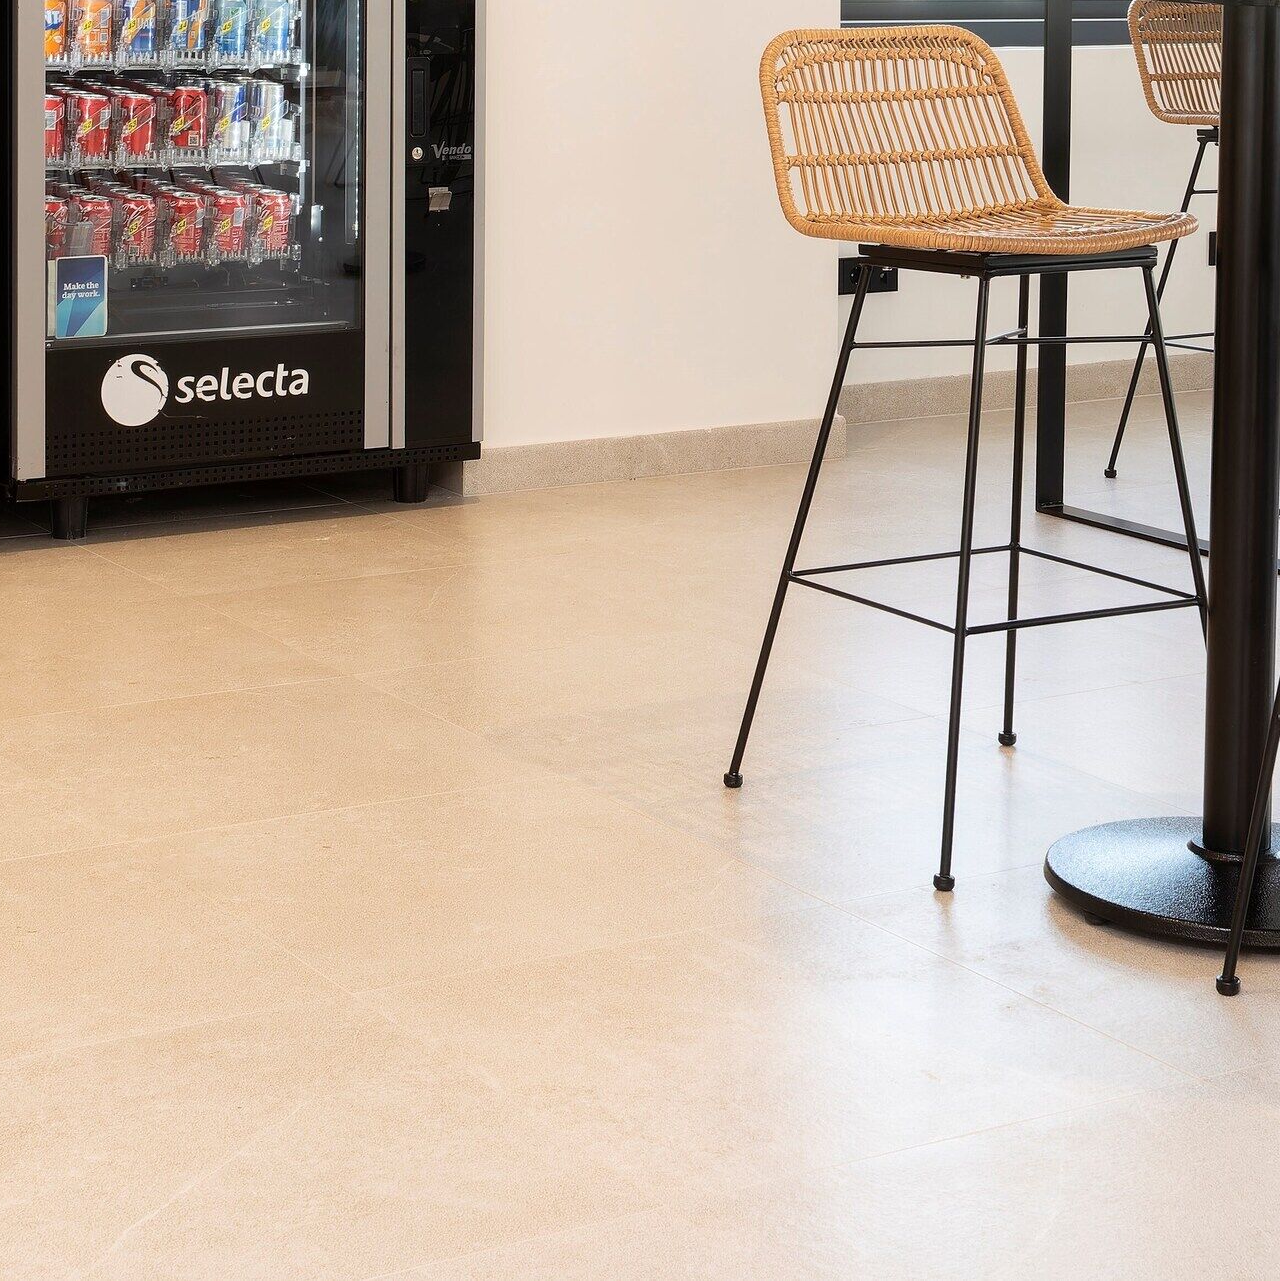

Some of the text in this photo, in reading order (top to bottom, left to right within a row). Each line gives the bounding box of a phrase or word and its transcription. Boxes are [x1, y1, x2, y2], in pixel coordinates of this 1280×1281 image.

[431, 141, 472, 159] Vendo
[63, 281, 99, 291] Make the
[62, 290, 101, 301] day work.
[174, 363, 309, 403] selecta
